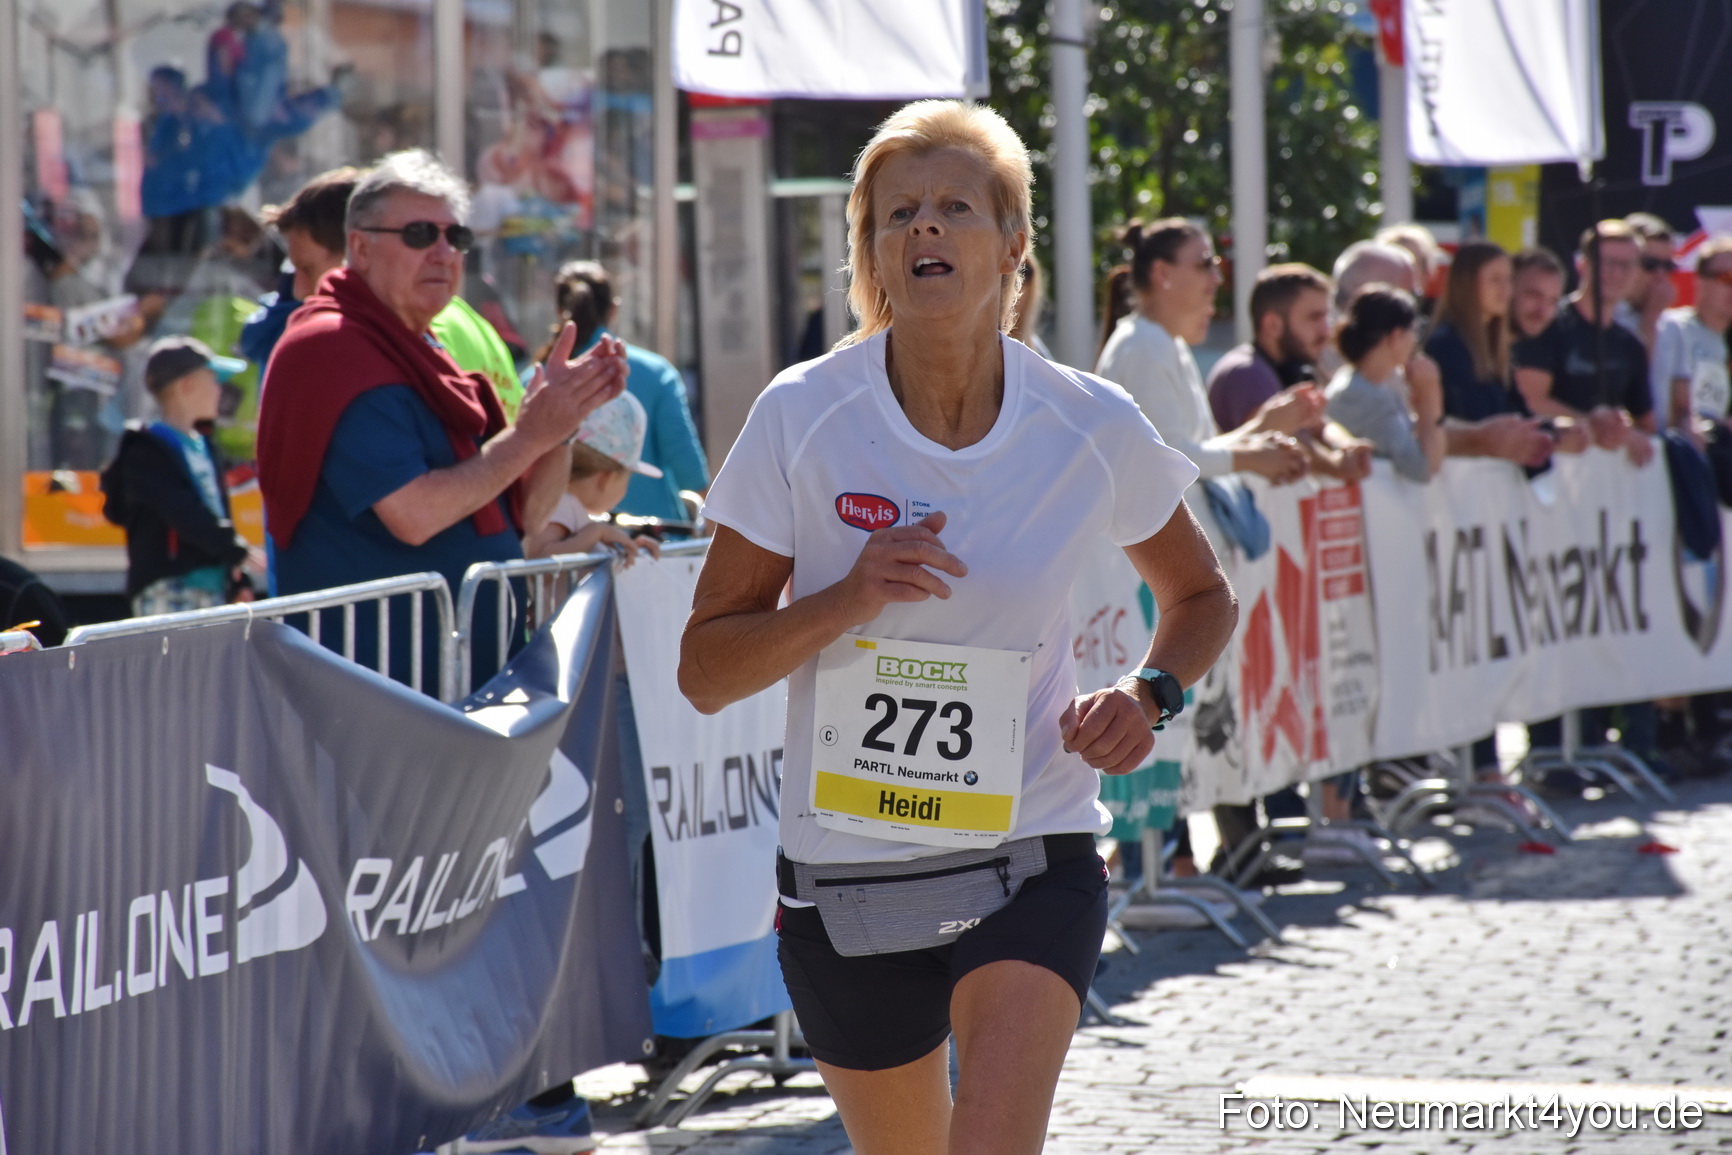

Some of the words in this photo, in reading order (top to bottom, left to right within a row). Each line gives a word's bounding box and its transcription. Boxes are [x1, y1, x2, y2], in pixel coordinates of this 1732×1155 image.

[841, 496, 895, 524] Hervis
[877, 656, 968, 683] BOCK
[875, 676, 904, 686] inspired
[904, 680, 914, 688] by
[936, 683, 968, 692] concepts
[861, 693, 973, 761] 273
[853, 758, 895, 776] PARTL
[897, 766, 959, 783] Neumarkt
[878, 790, 942, 821] Heidi
